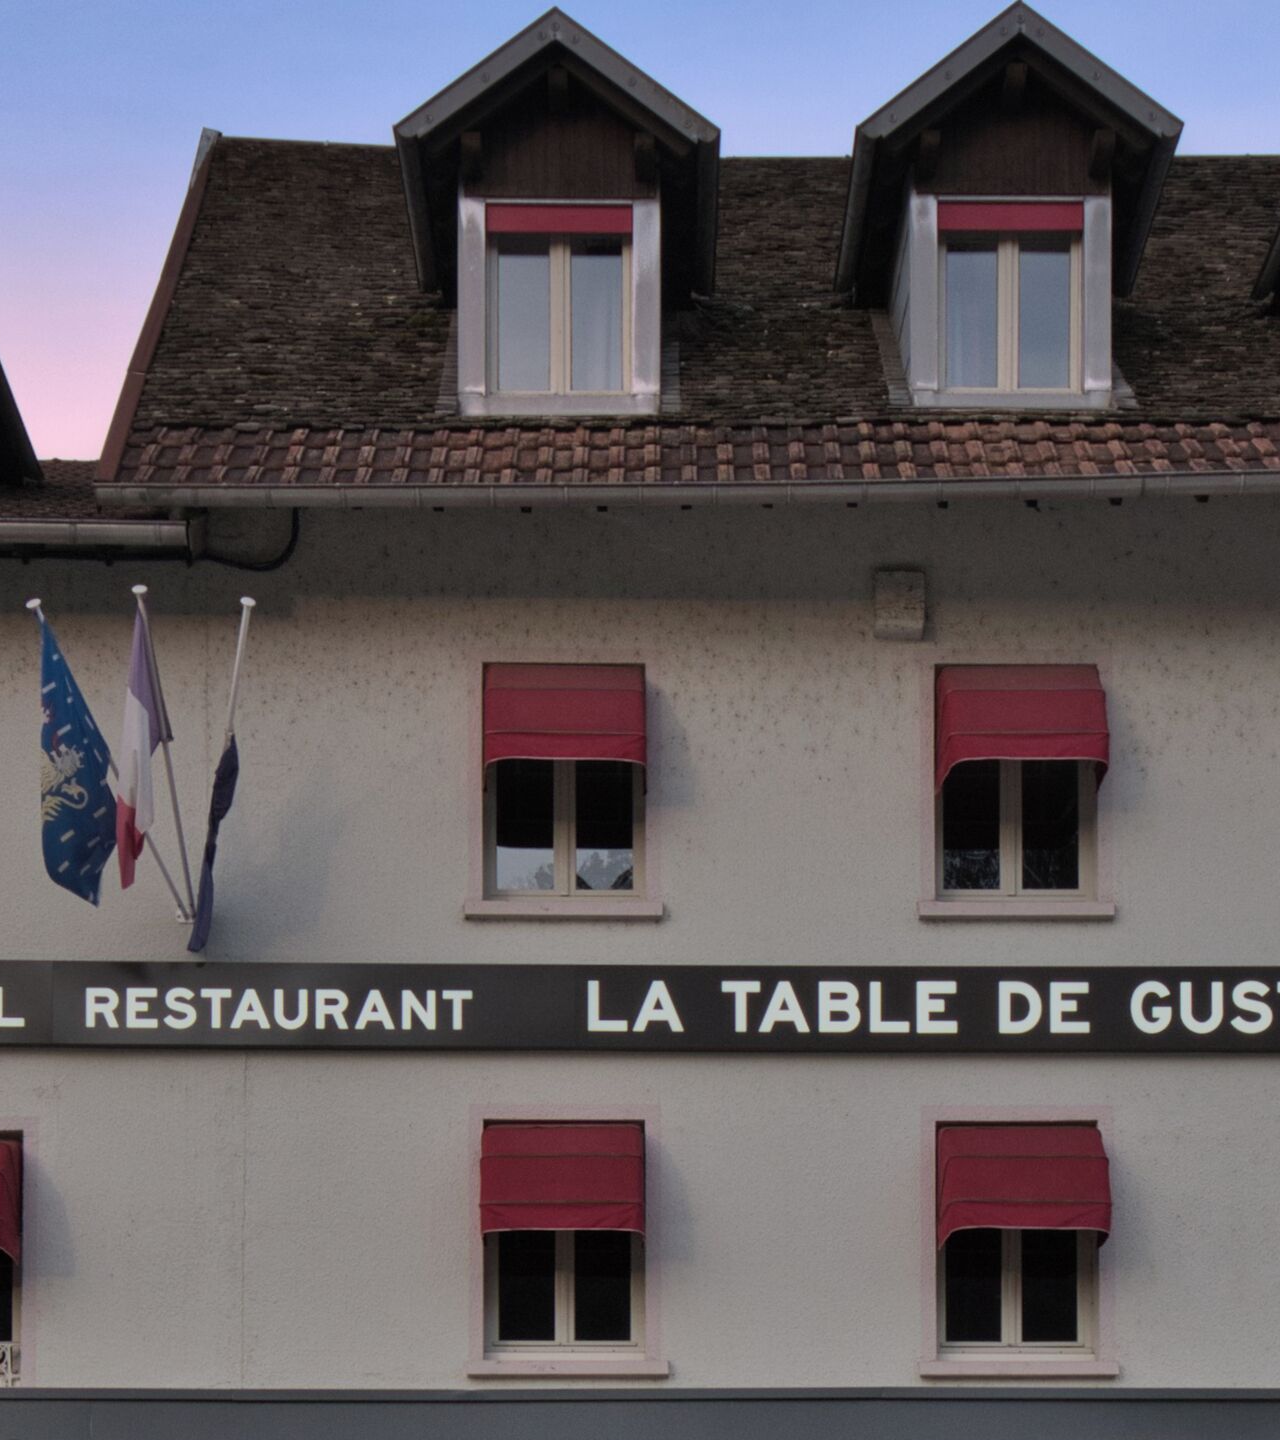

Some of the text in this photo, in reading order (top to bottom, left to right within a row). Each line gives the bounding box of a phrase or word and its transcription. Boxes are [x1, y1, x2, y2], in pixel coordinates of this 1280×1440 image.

[84, 985, 475, 1032] RESTAURANT
[586, 979, 685, 1034] LA
[720, 979, 960, 1035] TABLE
[997, 979, 1092, 1036] DE
